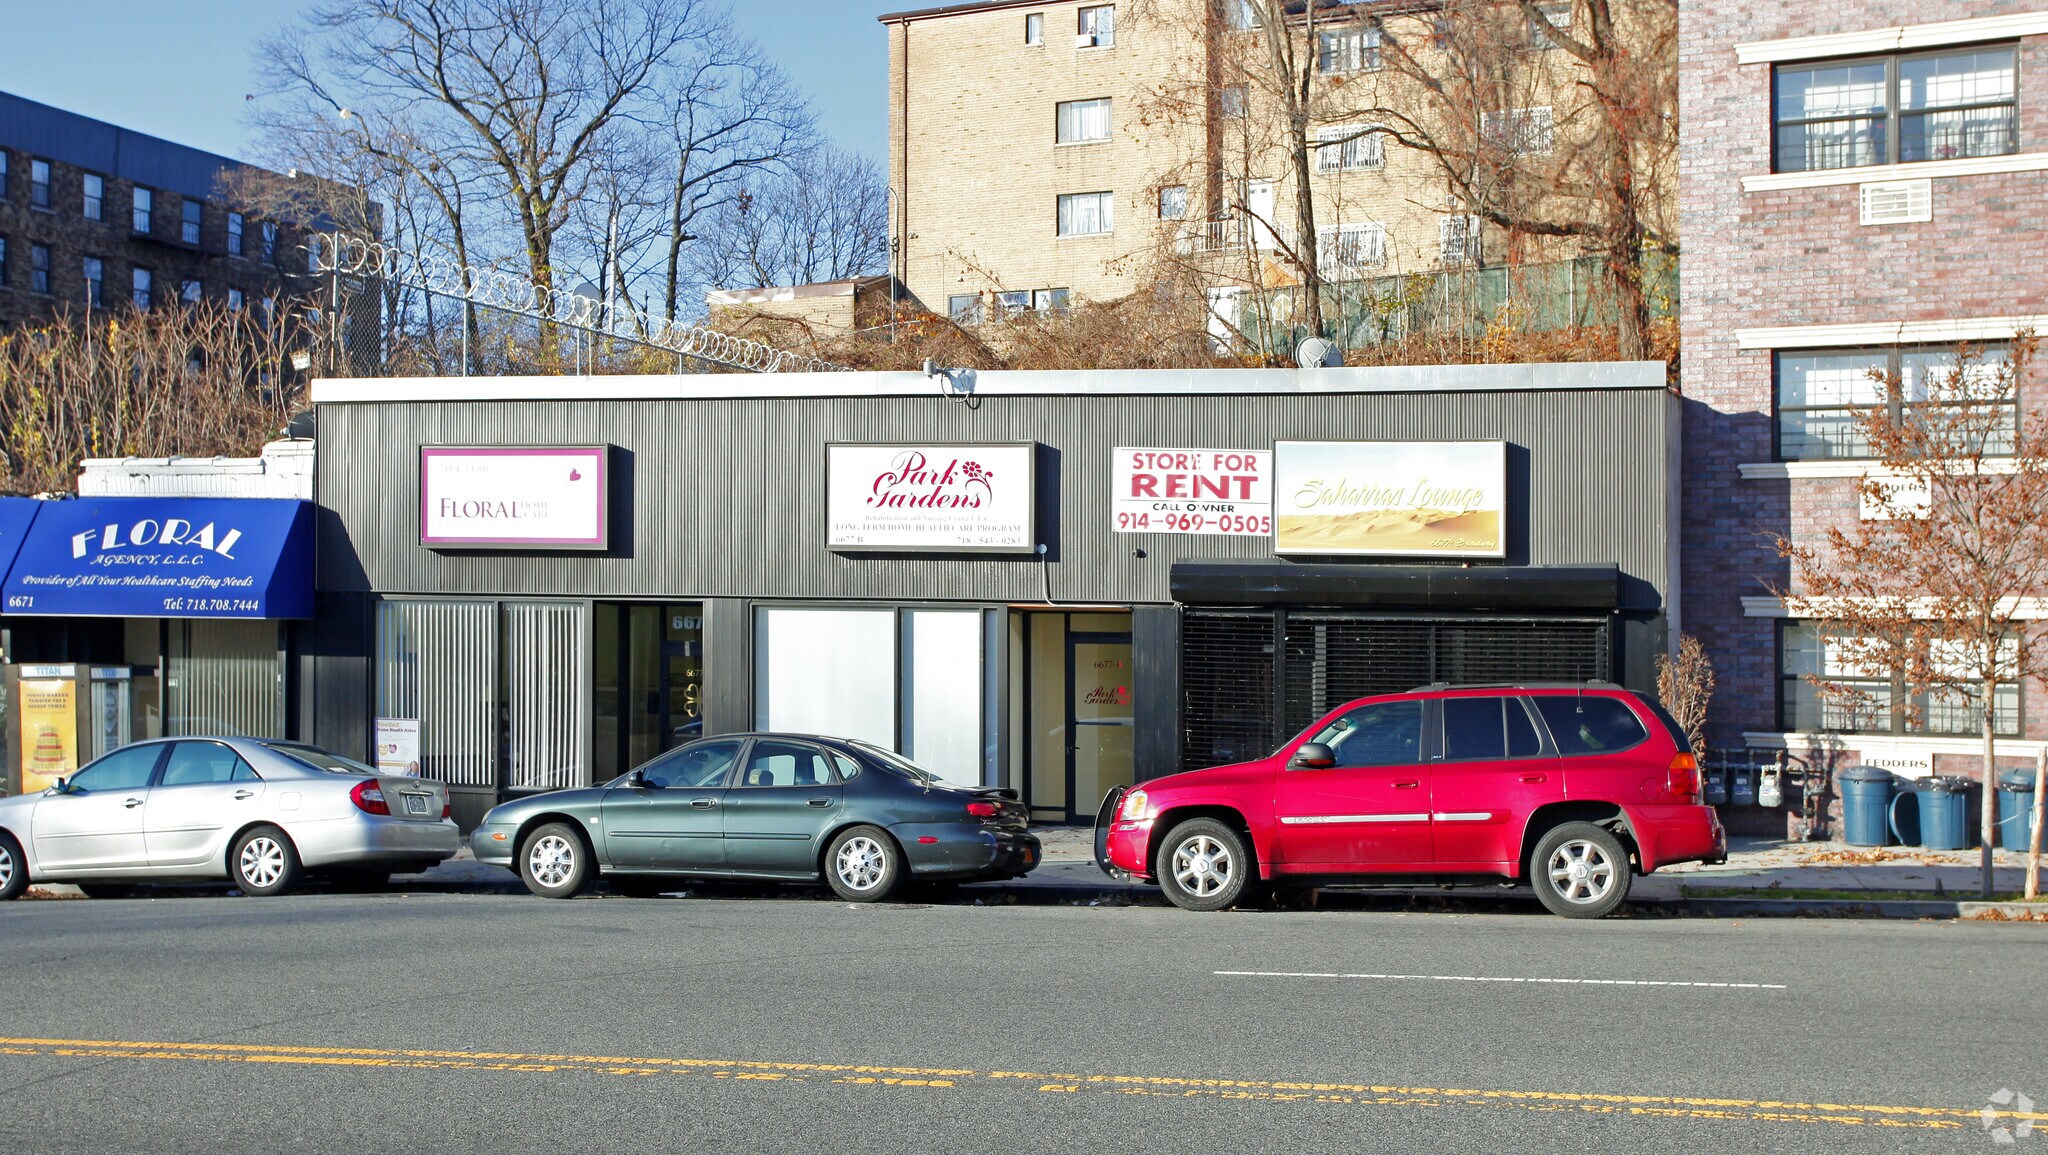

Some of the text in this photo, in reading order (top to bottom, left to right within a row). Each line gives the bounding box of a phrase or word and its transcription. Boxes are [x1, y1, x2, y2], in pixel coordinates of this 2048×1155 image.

[891, 450, 958, 485] Park
[1132, 452, 1257, 471] STORE FOR
[866, 471, 981, 508] Gardens
[1131, 473, 1258, 500] RENT
[1407, 479, 1484, 517] Lounge
[441, 497, 522, 518] FLORAL
[1152, 503, 1235, 513] CALL OWNER
[836, 523, 860, 531] LONG
[862, 523, 886, 532] TERM
[888, 524, 912, 532] HOME
[915, 524, 950, 532] HEALTH
[951, 524, 973, 532] CARE
[1117, 512, 1270, 533] 914-969-0505
[72, 519, 242, 560] FLORAL
[1455, 537, 1497, 550] Broadway
[89, 554, 204, 566] AGENCY, L.L.C.
[23, 574, 254, 589] Provider of All Your Healthcare Staffing Needs
[9, 596, 34, 607] 6671
[163, 597, 259, 611] Tel: 718.708.7444
[35, 666, 61, 675] TITAN
[1865, 758, 1928, 768] FEDDERS
